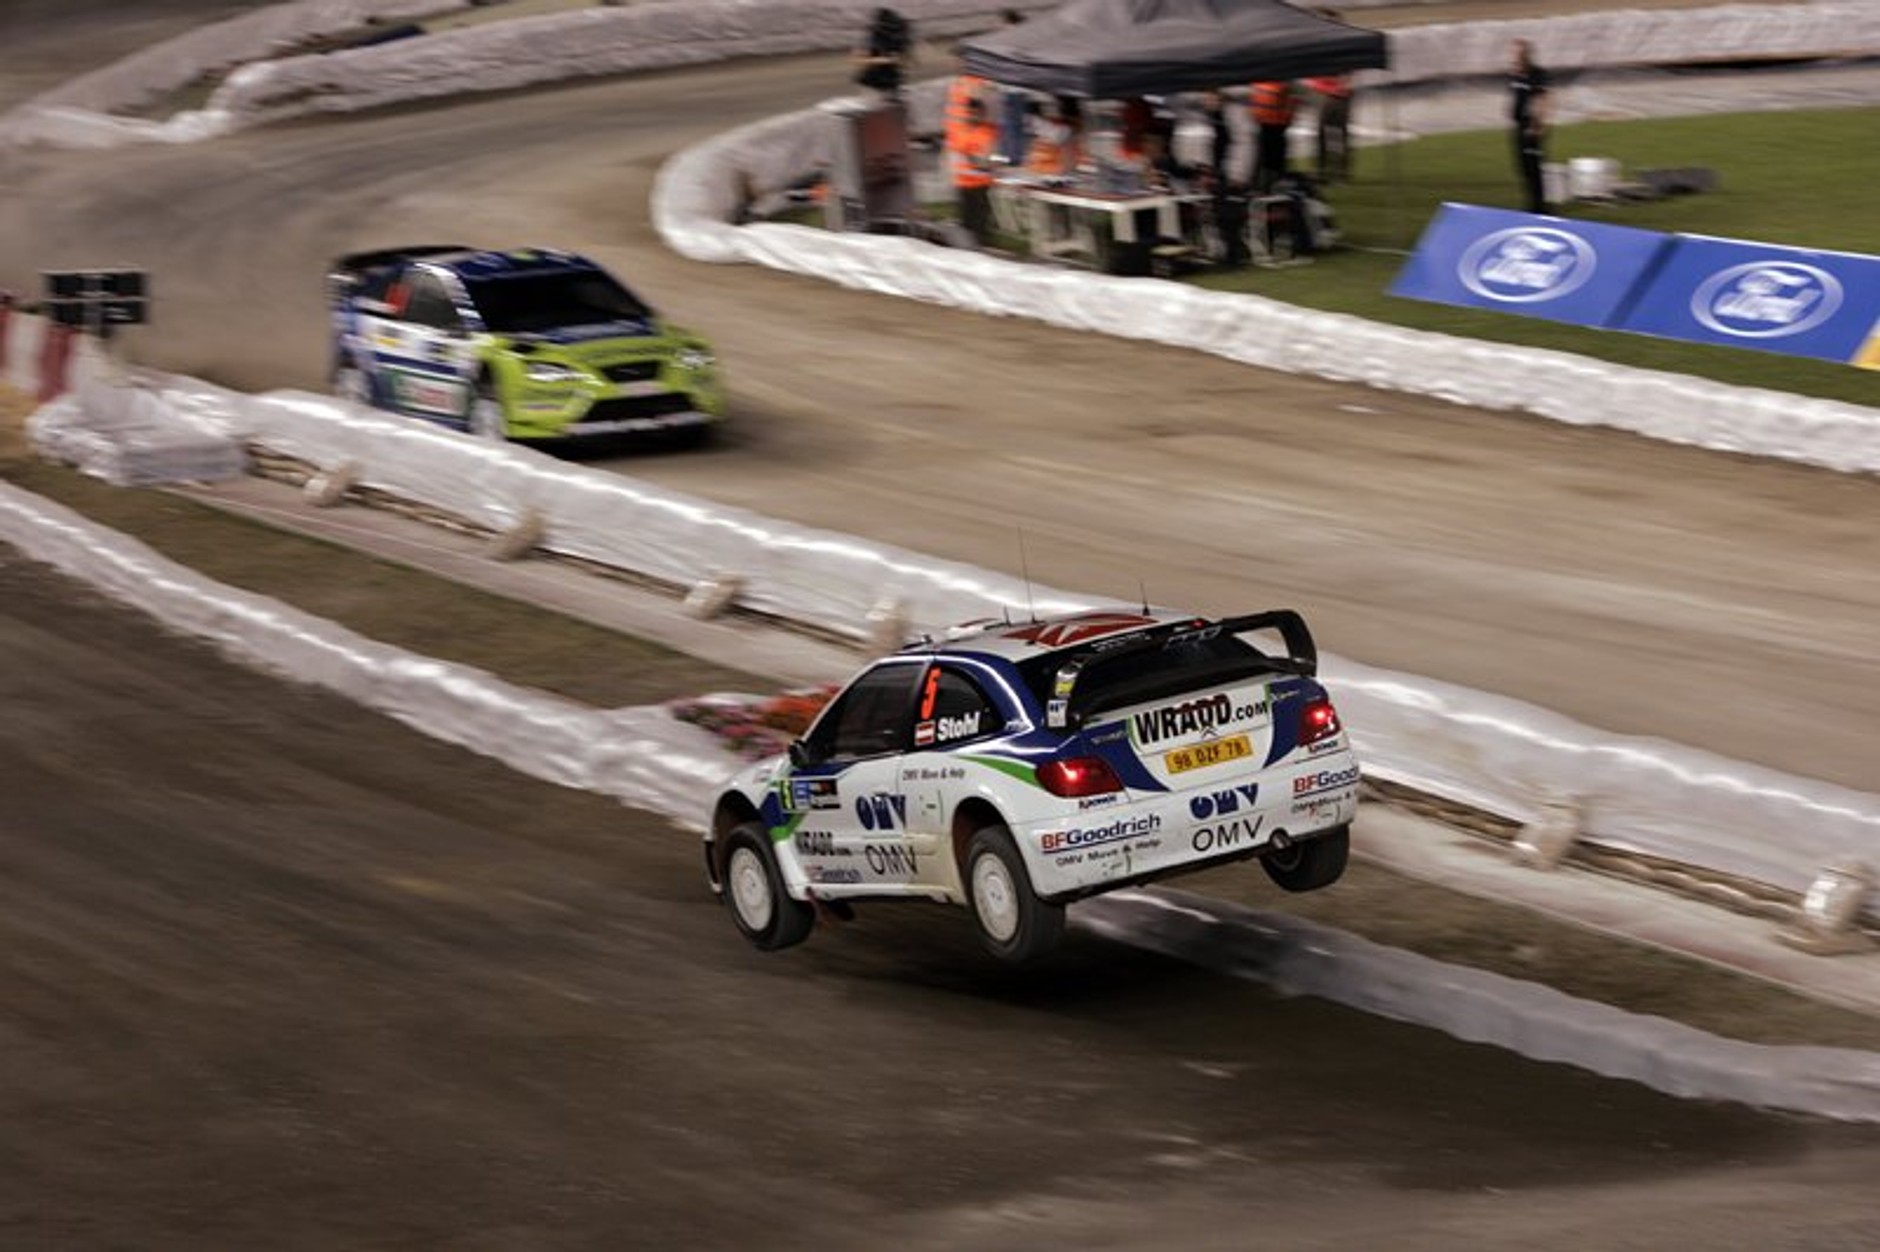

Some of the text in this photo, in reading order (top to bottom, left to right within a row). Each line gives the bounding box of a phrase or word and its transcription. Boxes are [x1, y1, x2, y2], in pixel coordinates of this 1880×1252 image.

[921, 665, 942, 720] 5
[937, 711, 981, 741] Stohl
[1293, 766, 1360, 793] BFGood
[1041, 814, 1161, 850] BFGoodrich
[1192, 815, 1263, 852] OMV
[865, 844, 918, 875] OMV
